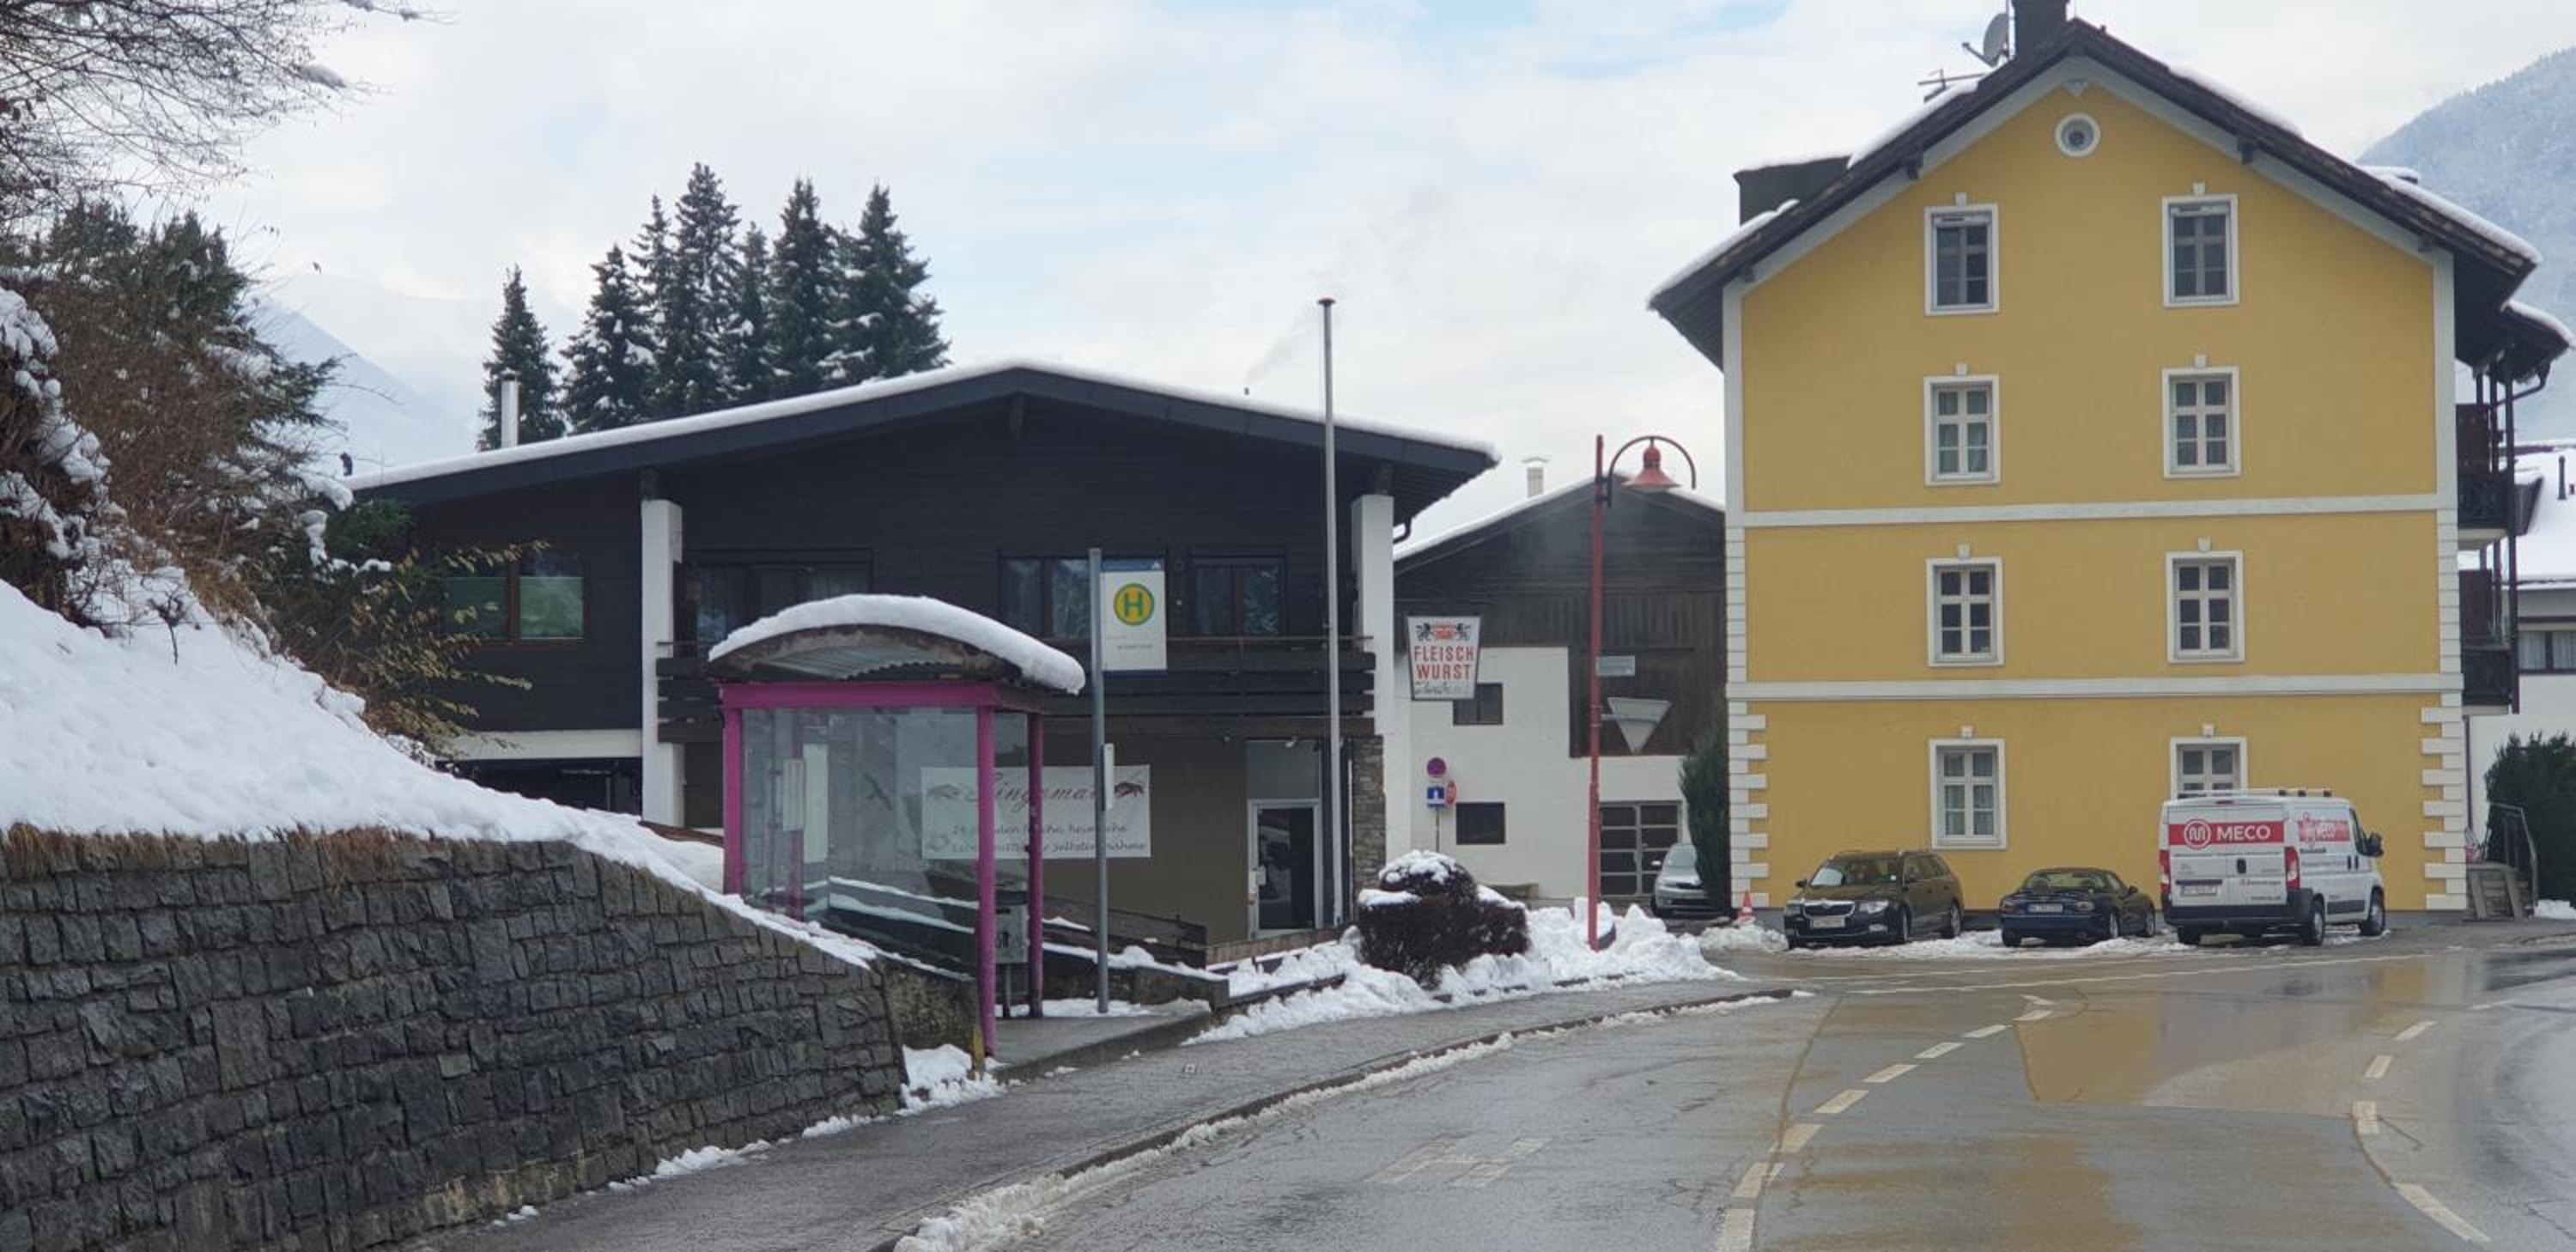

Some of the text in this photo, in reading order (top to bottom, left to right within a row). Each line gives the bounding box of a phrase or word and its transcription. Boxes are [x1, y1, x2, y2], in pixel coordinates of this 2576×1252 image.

[1414, 646, 1474, 661] FLEISCH
[1417, 664, 1471, 680] WURST
[2216, 825, 2270, 842] MECO
